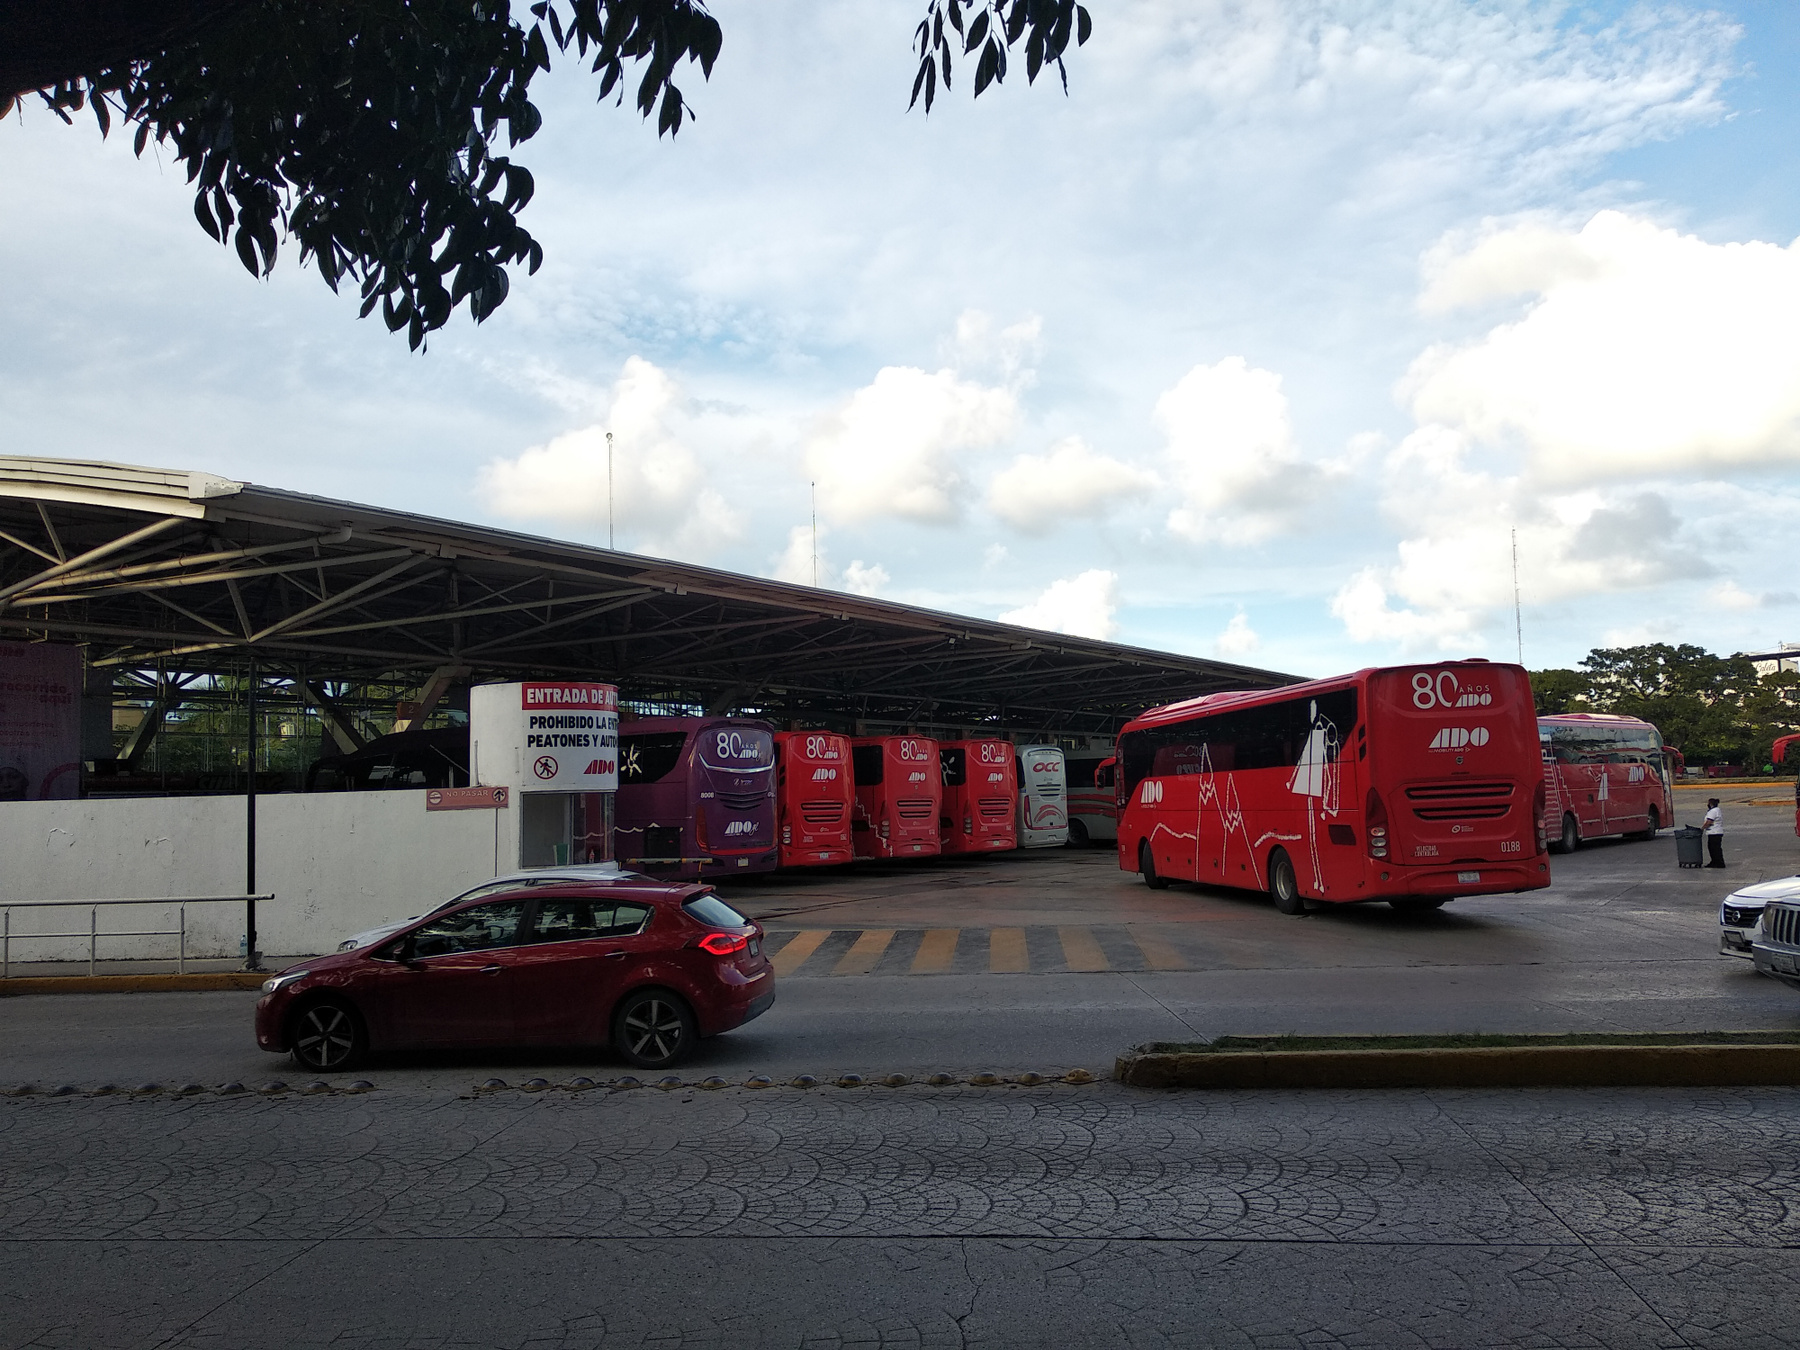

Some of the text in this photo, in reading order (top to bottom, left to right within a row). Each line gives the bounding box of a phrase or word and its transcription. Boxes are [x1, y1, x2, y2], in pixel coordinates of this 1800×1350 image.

[1411, 670, 1459, 710] 80
[1459, 684, 1490, 693] AÑOS
[526, 688, 590, 704] ENTRADA
[591, 689, 603, 704] DE
[1454, 693, 1492, 708] ADO
[408, 705, 415, 714] 2
[529, 716, 594, 729] PROHIBIDO
[596, 717, 606, 730] LA
[527, 734, 590, 748] PEATONES
[592, 735, 599, 748] Y
[1428, 727, 1490, 749] ADO
[716, 732, 742, 759] 80
[806, 736, 826, 759] 80
[900, 740, 917, 760] 80
[823, 751, 838, 759] ADO
[981, 744, 996, 762] 80
[583, 760, 615, 775] ADO
[811, 768, 837, 780] ADO
[1032, 761, 1061, 773] OCC
[908, 771, 926, 782] ADO
[987, 772, 1003, 782] ADO
[1628, 766, 1645, 783] ADO
[461, 789, 489, 797] PASAR
[1140, 780, 1163, 804] ADO
[1500, 840, 1521, 853] 0188
